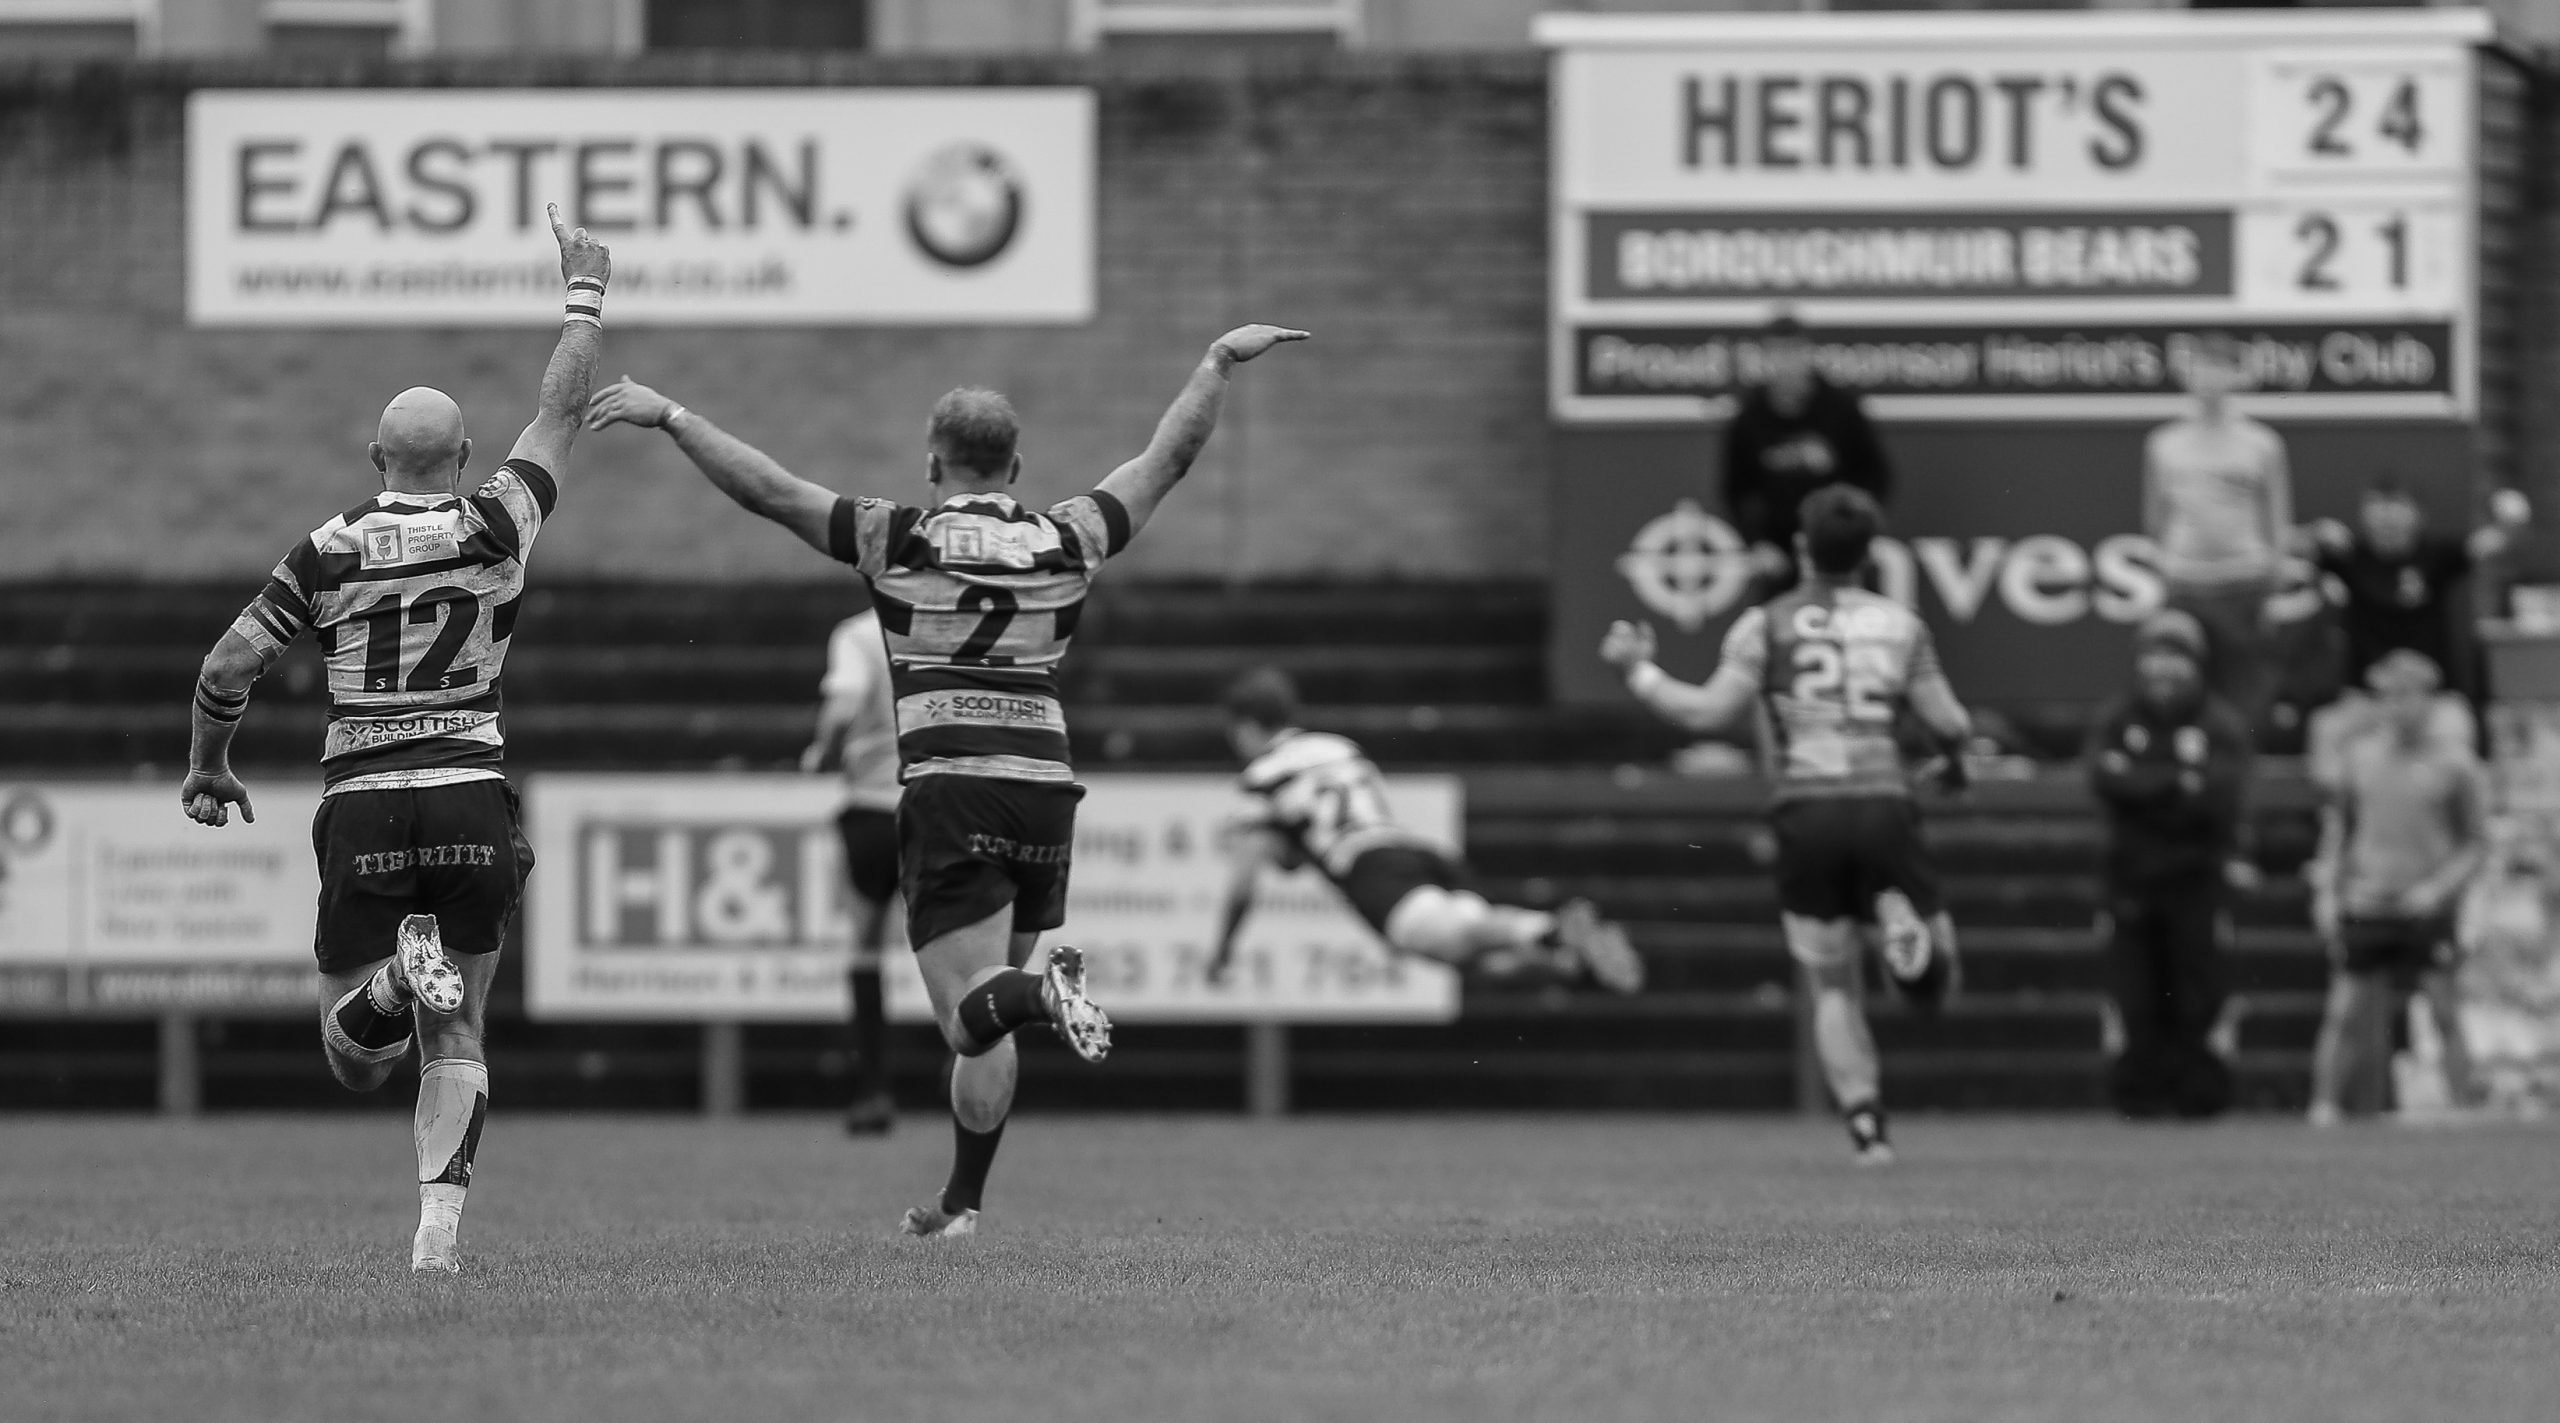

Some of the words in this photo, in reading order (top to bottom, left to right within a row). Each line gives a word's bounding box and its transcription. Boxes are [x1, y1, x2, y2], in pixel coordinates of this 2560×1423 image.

[1680, 74, 2147, 171] HERIOT'S
[1619, 228, 2012, 290] BOROUGHMUIR
[2019, 226, 2199, 288] BEARS
[407, 524, 443, 534] THISTLE
[408, 532, 454, 544] PROPERTY
[409, 543, 440, 554] GROUP
[951, 585, 1019, 665] 2
[349, 586, 480, 692] 12
[952, 696, 1046, 714] SCOTTISH
[371, 716, 476, 734] SCOTTISH
